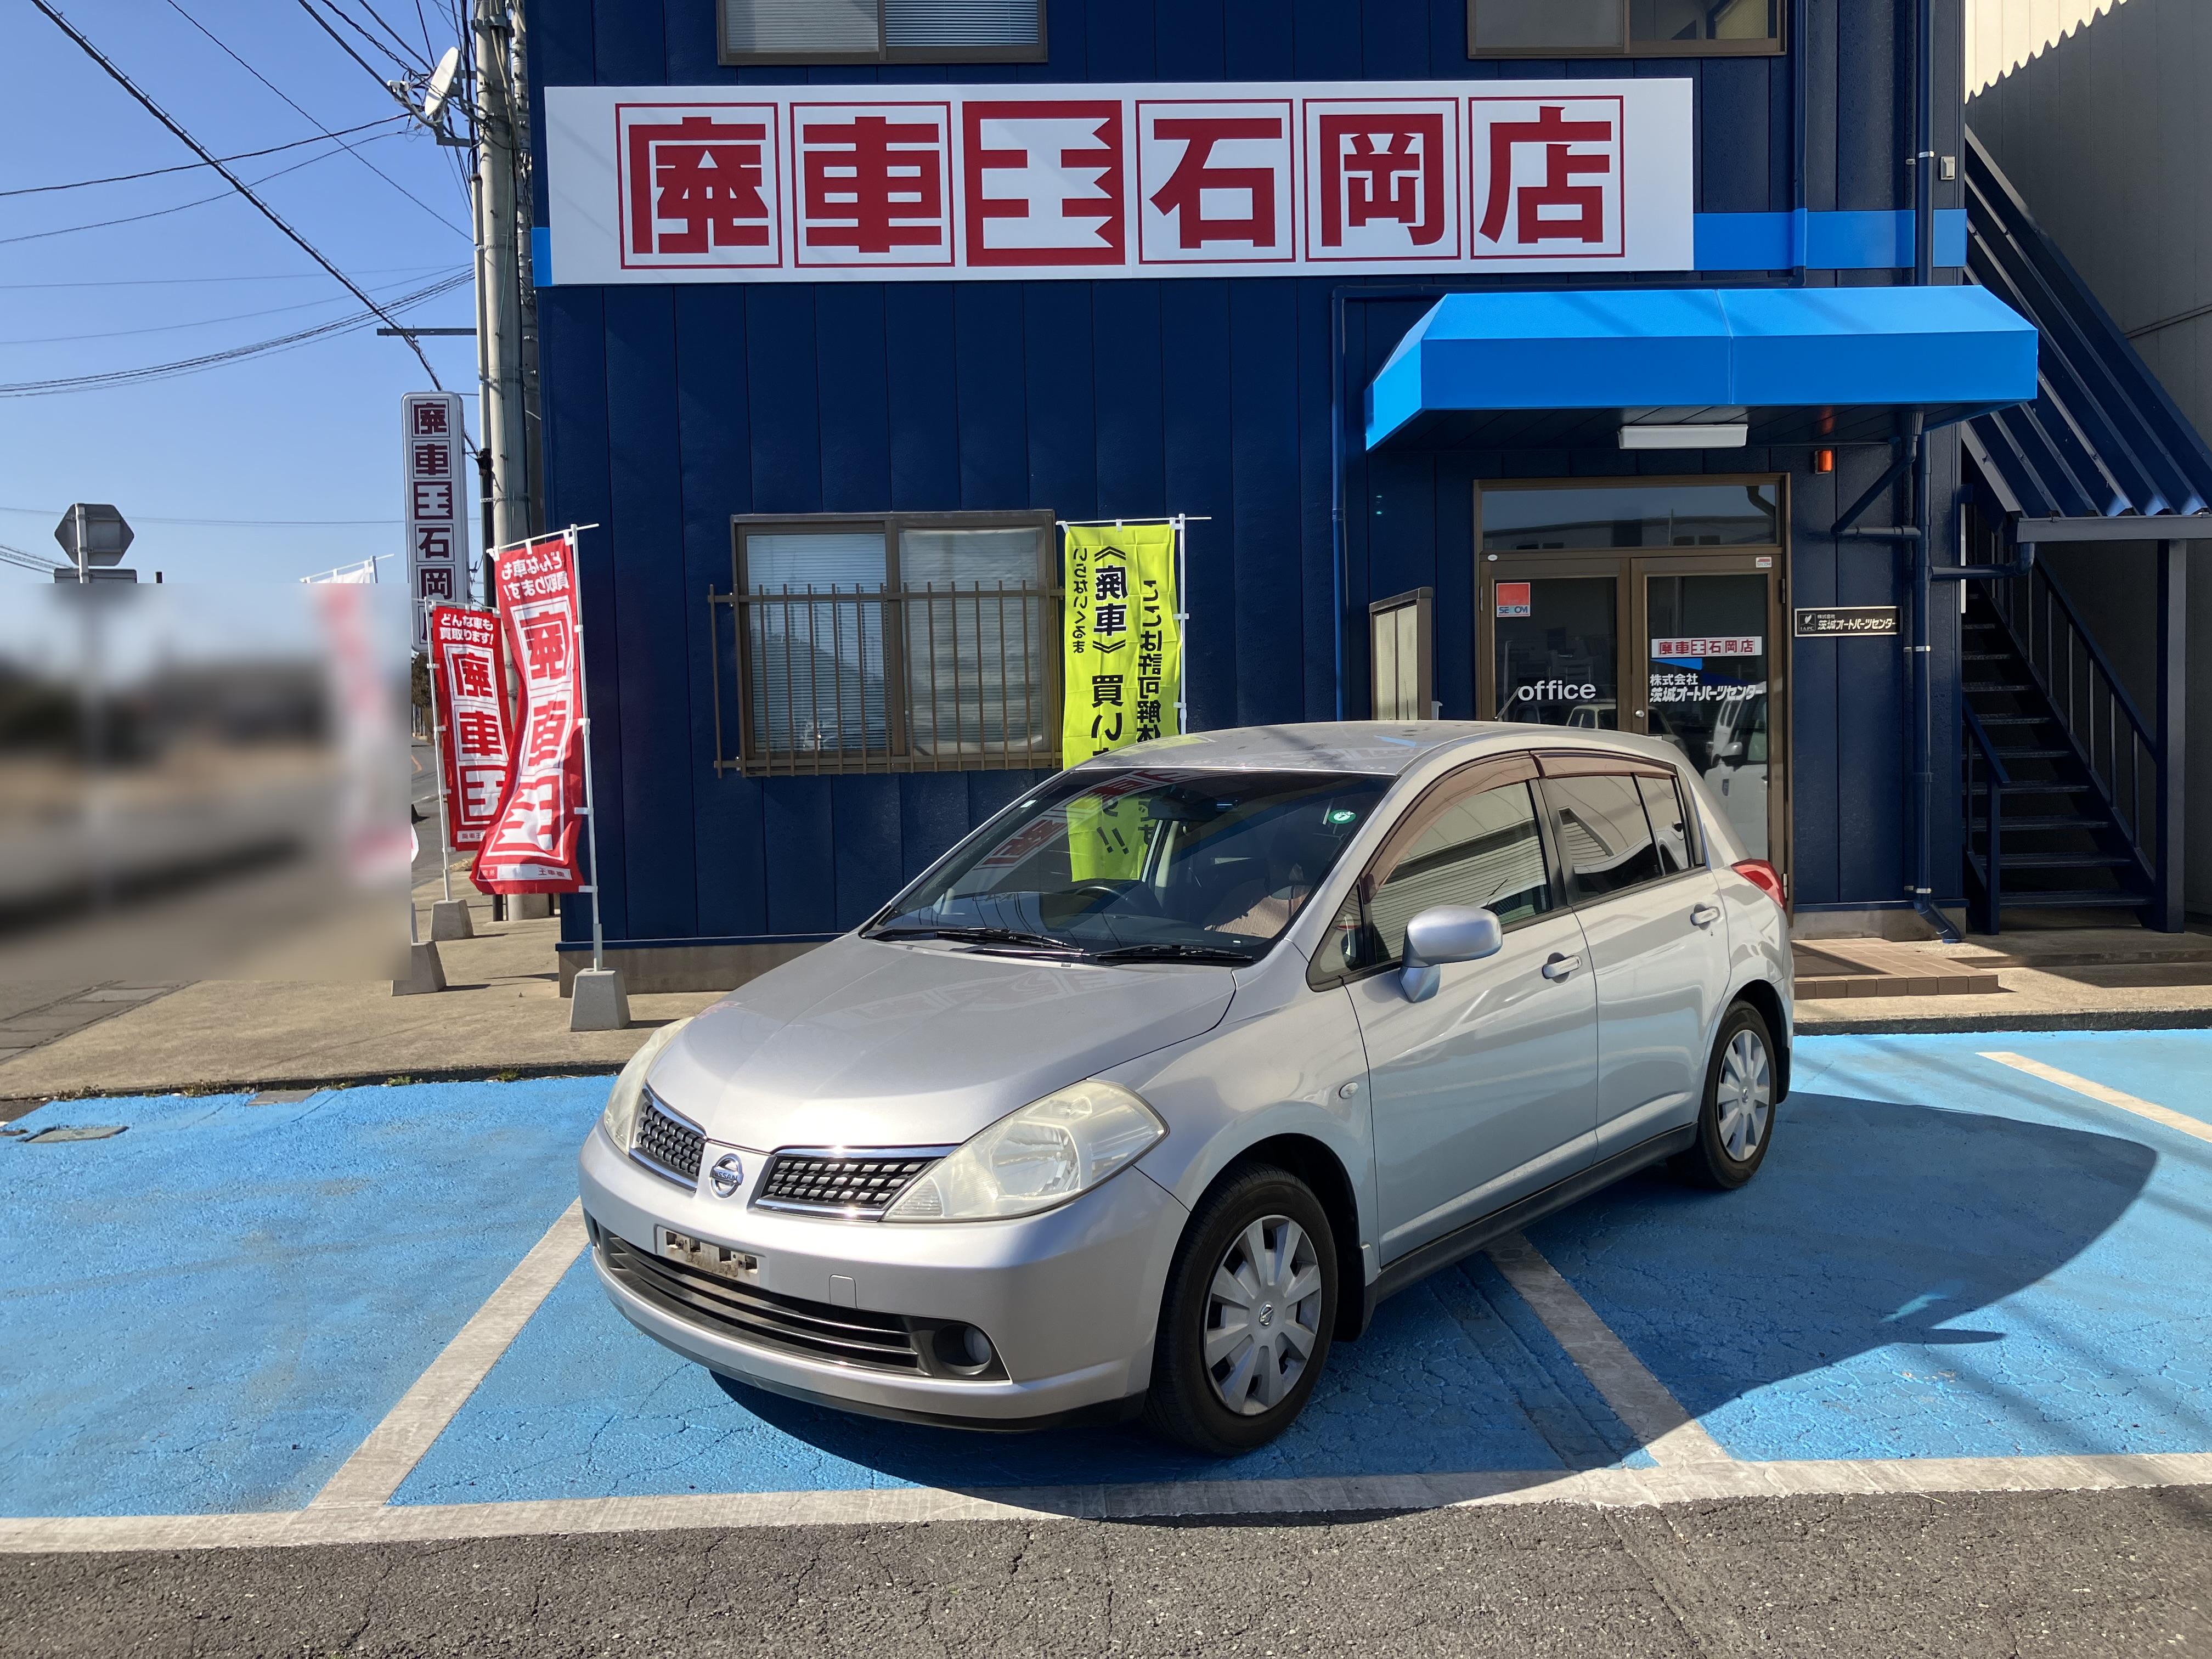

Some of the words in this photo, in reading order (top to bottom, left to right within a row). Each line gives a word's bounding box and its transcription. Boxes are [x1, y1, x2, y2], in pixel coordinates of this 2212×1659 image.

[628, 100, 1612, 267] 廃車王石岡店
[413, 402, 454, 641] 廃車王石岡
[441, 613, 494, 631] どんな車も
[1659, 638, 1754, 656] 廃車王石岡店
[1650, 673, 1699, 686] 株式会社
[1517, 680, 1596, 701] office
[1650, 685, 1763, 703] 茨城オートパーツセンター
[451, 651, 505, 824] 廃車王
